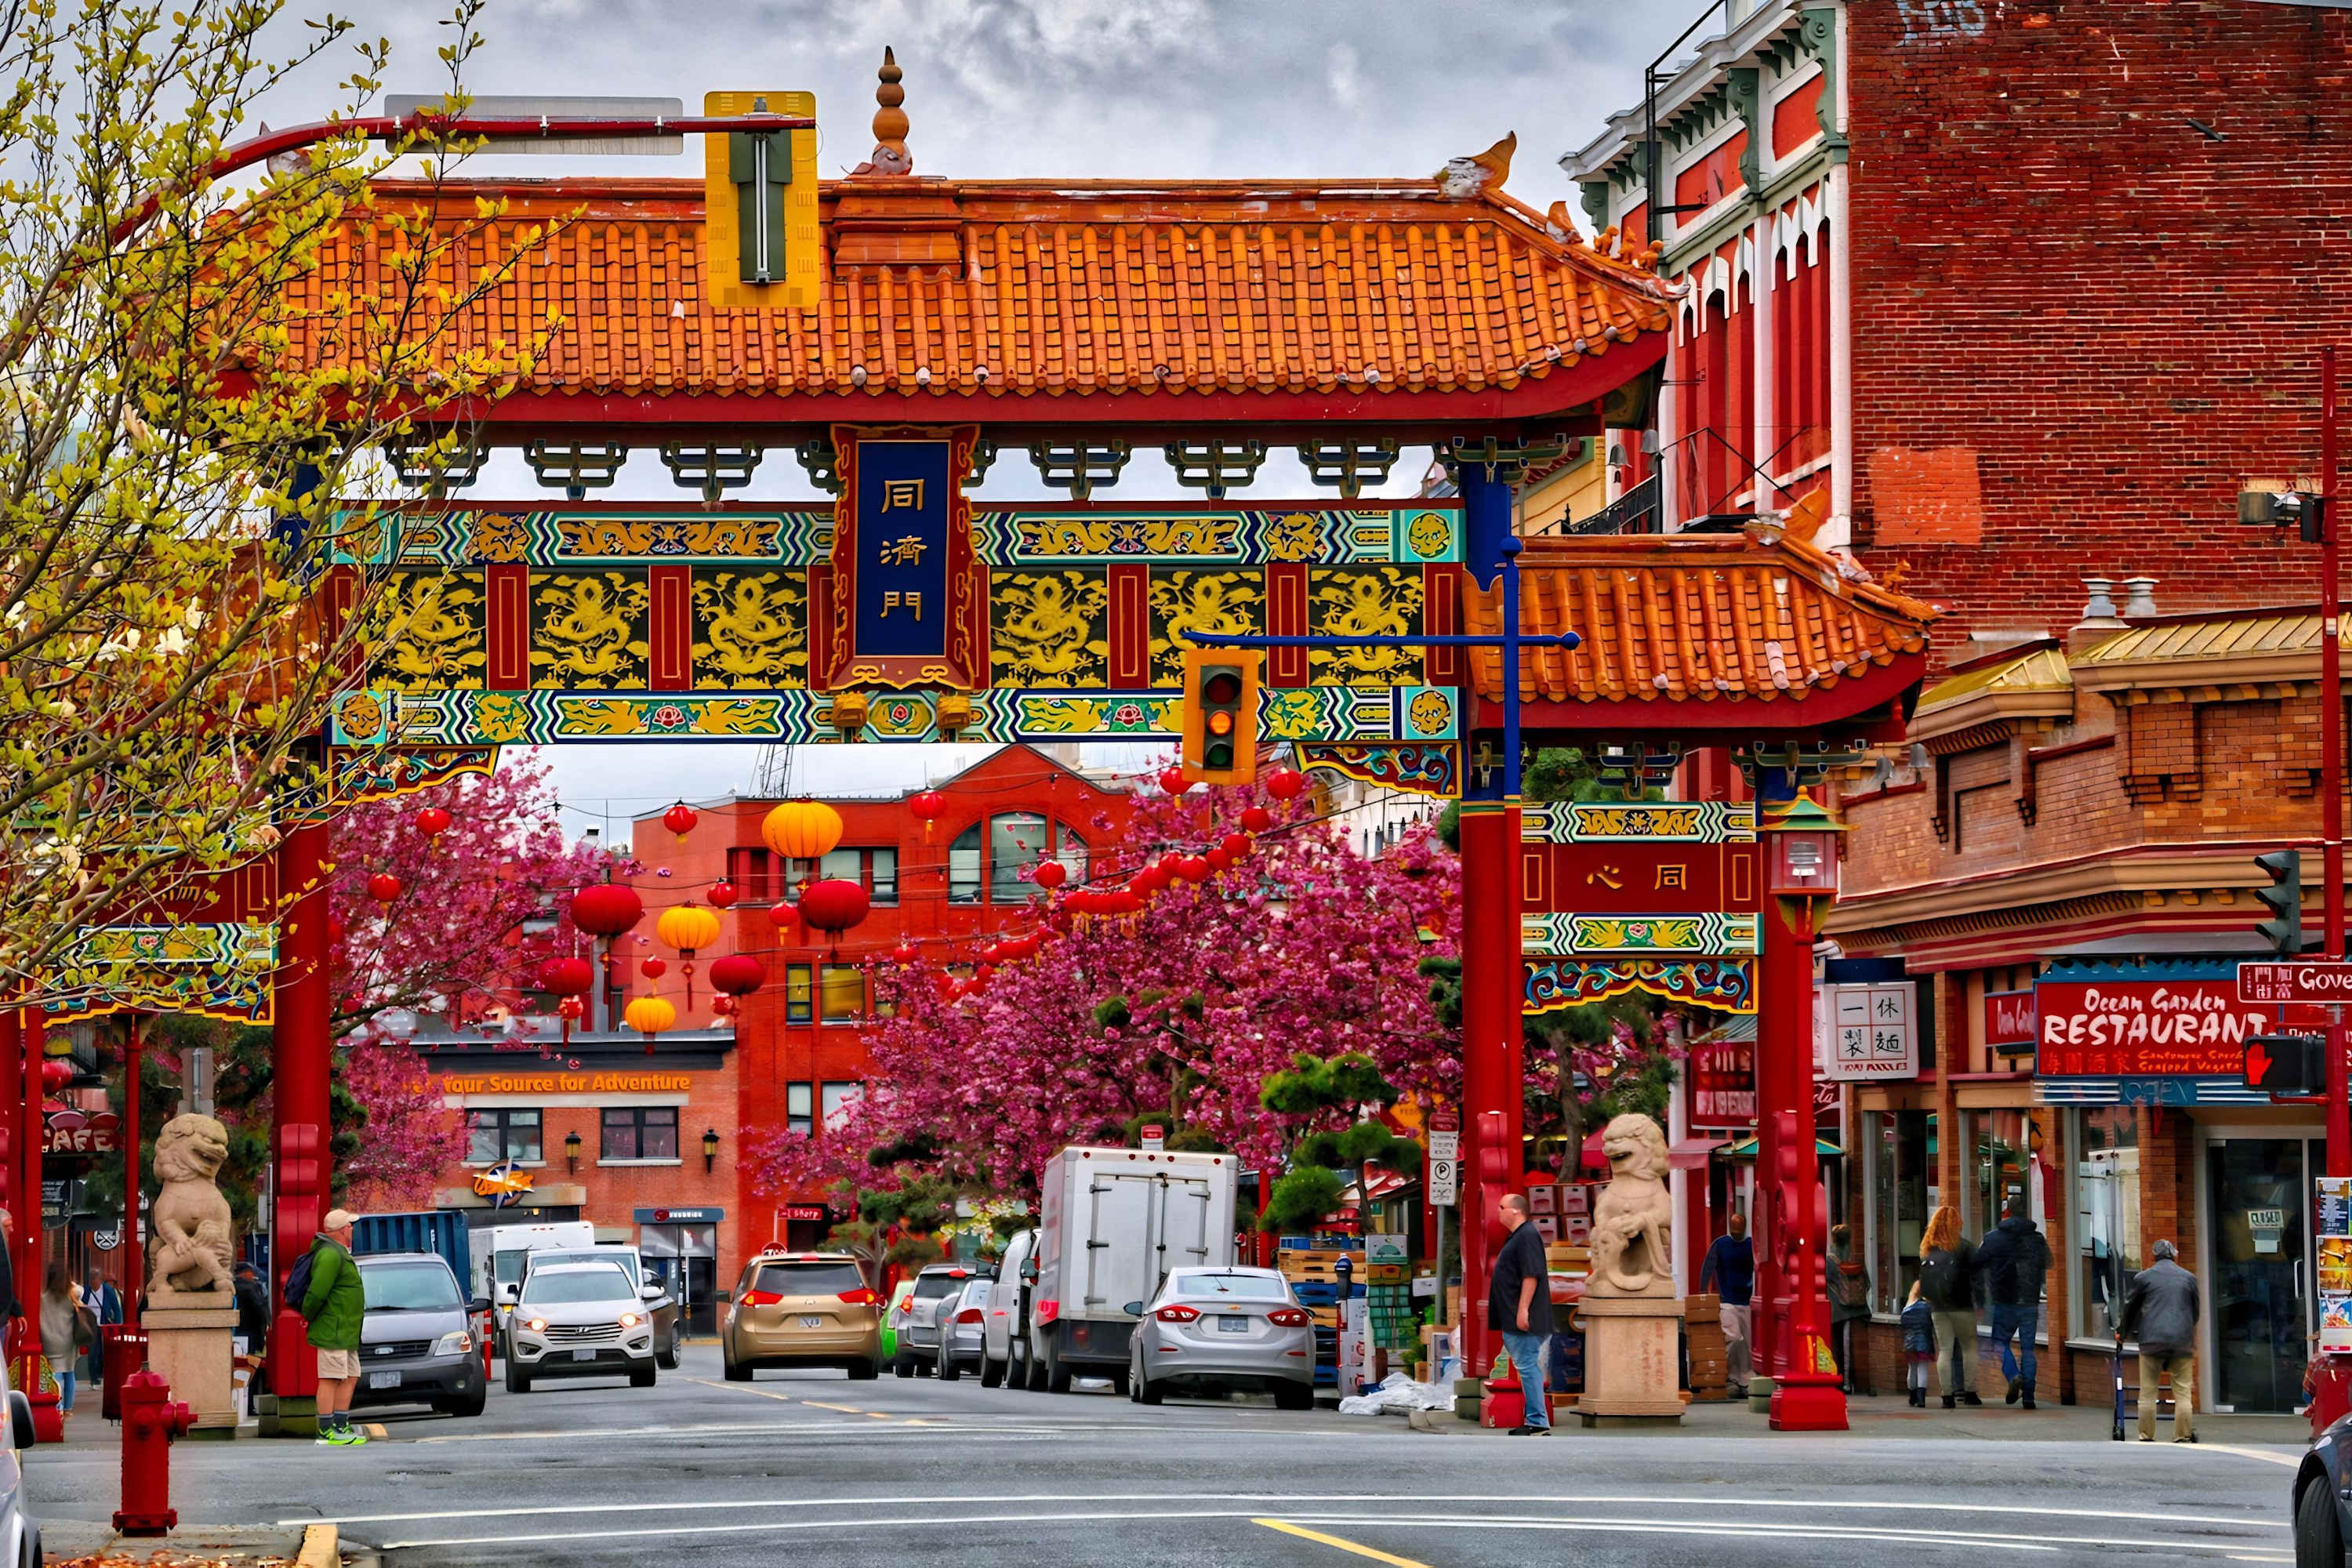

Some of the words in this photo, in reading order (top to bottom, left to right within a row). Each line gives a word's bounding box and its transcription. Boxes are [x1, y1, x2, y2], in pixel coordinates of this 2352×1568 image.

[880, 478, 927, 622] 同濟門
[2085, 988, 2143, 1013] Ocean
[2151, 987, 2226, 1013] Garden
[2044, 1011, 2267, 1046] RESTAURANT
[442, 1077, 485, 1094] Your
[489, 1076, 554, 1094] Source
[558, 1073, 586, 1092] for
[592, 1073, 691, 1091] Adventure
